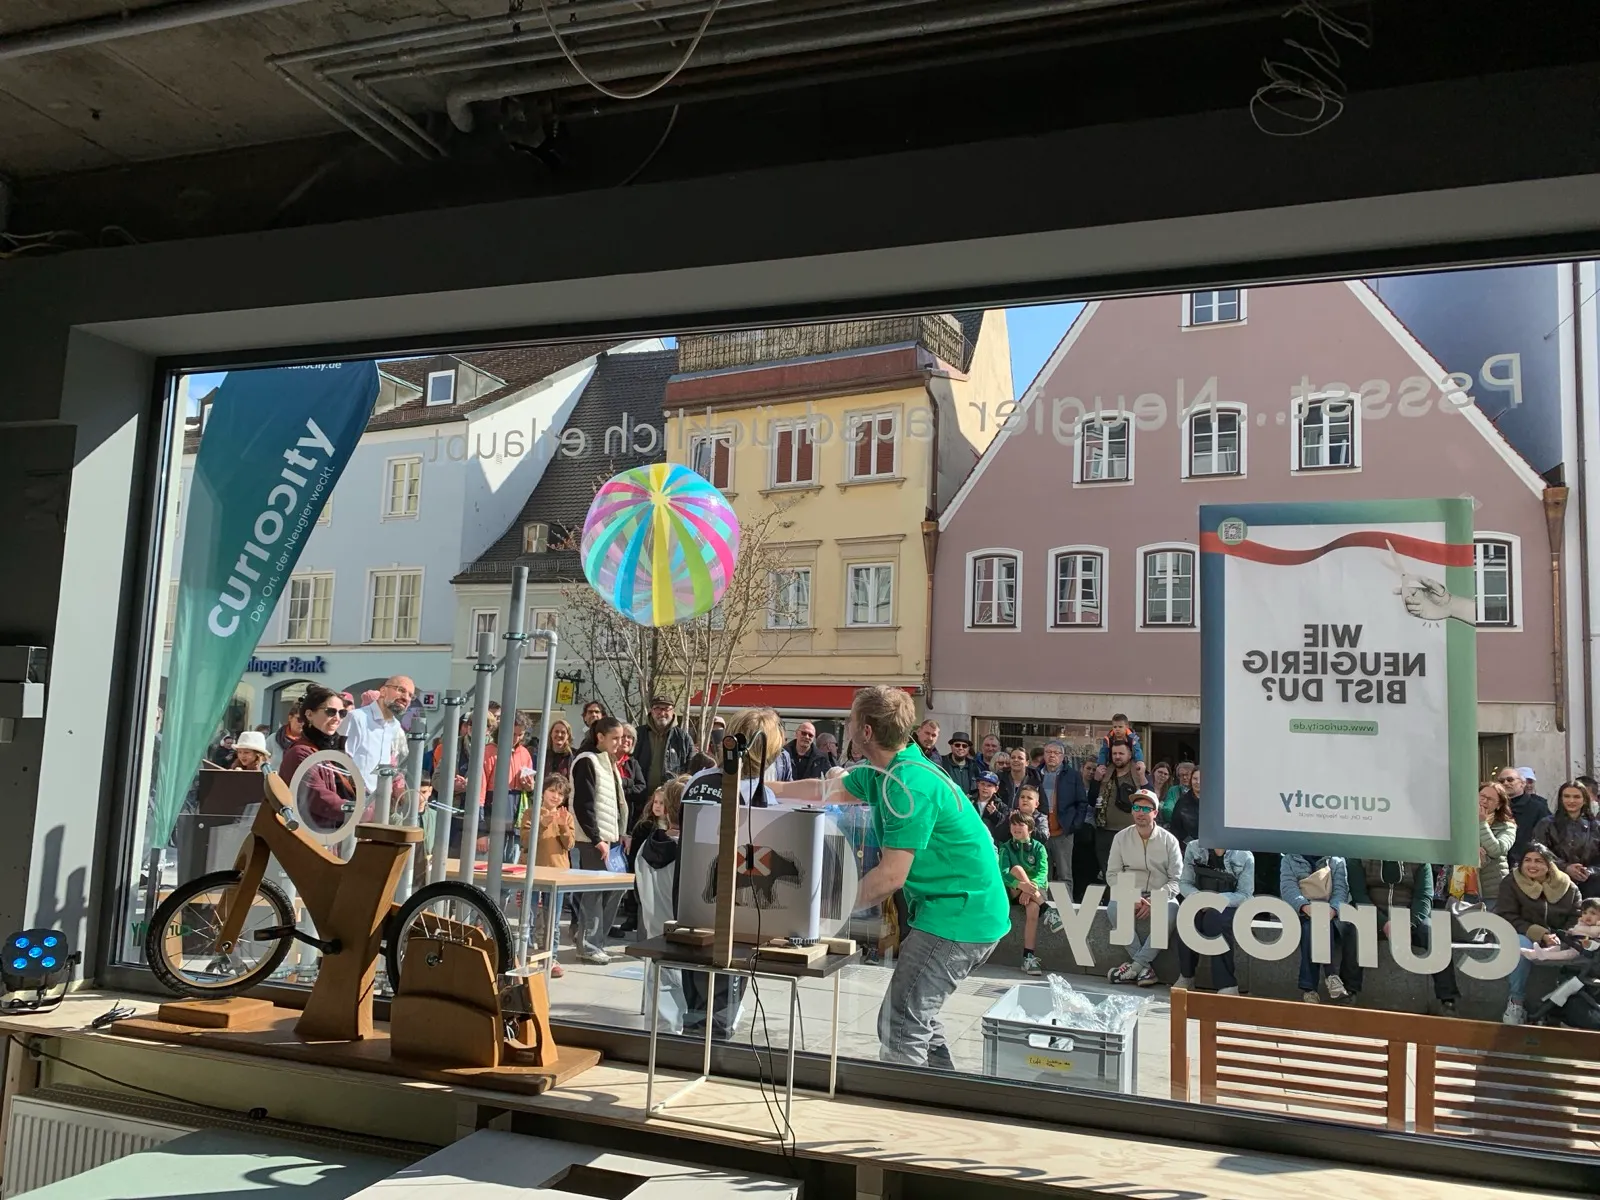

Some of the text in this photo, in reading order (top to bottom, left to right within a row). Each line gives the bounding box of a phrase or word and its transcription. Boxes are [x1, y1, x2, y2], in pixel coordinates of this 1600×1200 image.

[207, 417, 336, 638] curiocity
[250, 464, 336, 622] Der Ort, der Neugier weckt.
[247, 655, 326, 677] inger Bank
[688, 783, 723, 799] SC Frei
